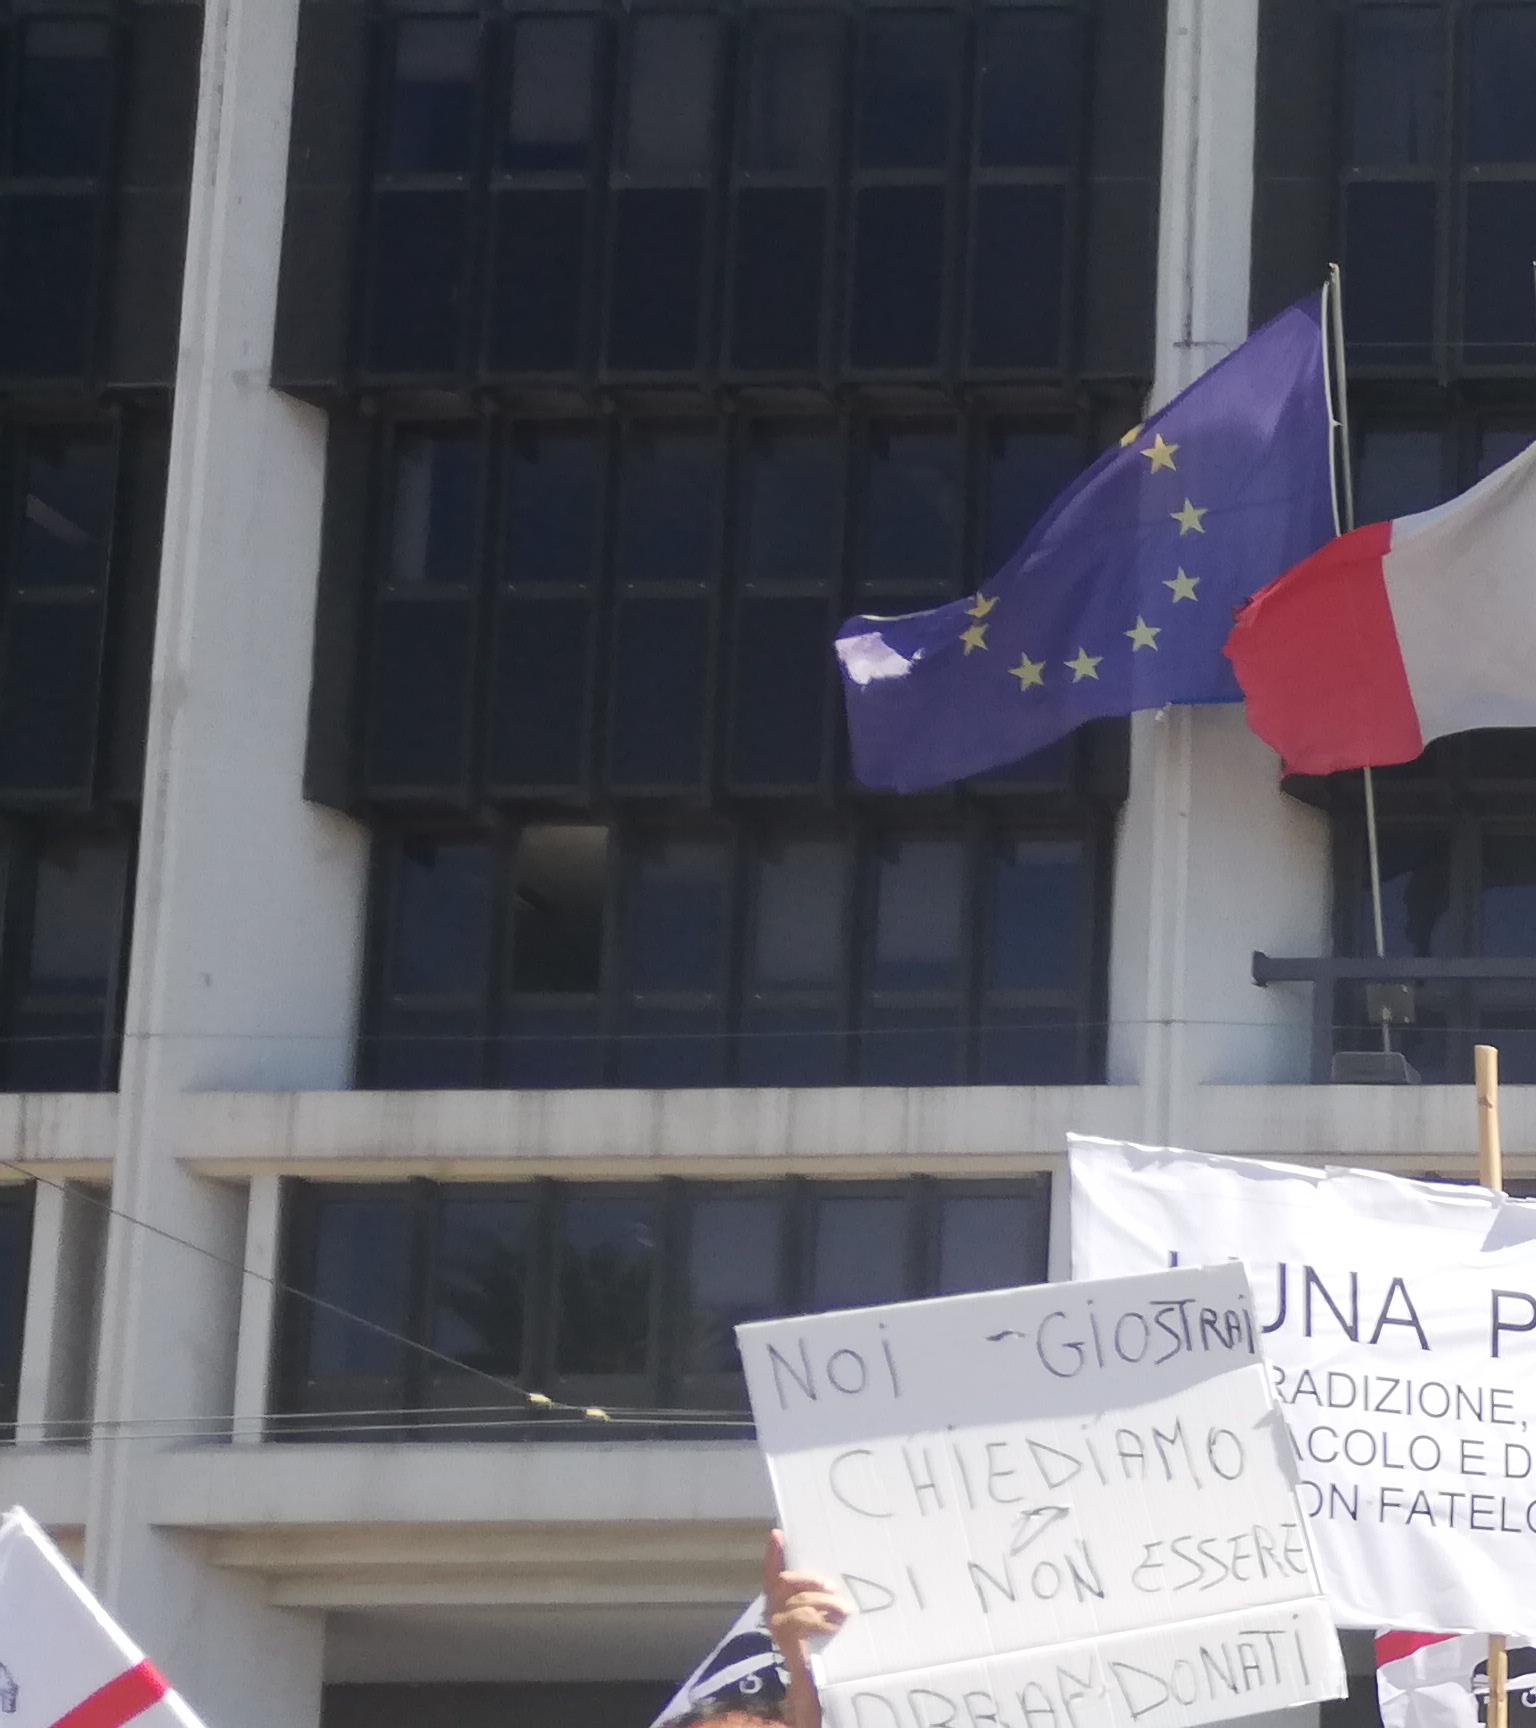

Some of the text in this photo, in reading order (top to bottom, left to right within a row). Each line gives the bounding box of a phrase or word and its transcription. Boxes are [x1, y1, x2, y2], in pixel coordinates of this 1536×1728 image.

[1272, 1367, 1530, 1433] RADIZIONE,
[828, 1413, 1247, 1518] CHIEDIAMO
[1460, 1440, 1487, 1477] E
[840, 1522, 1309, 1614] DI NON ESSERE
